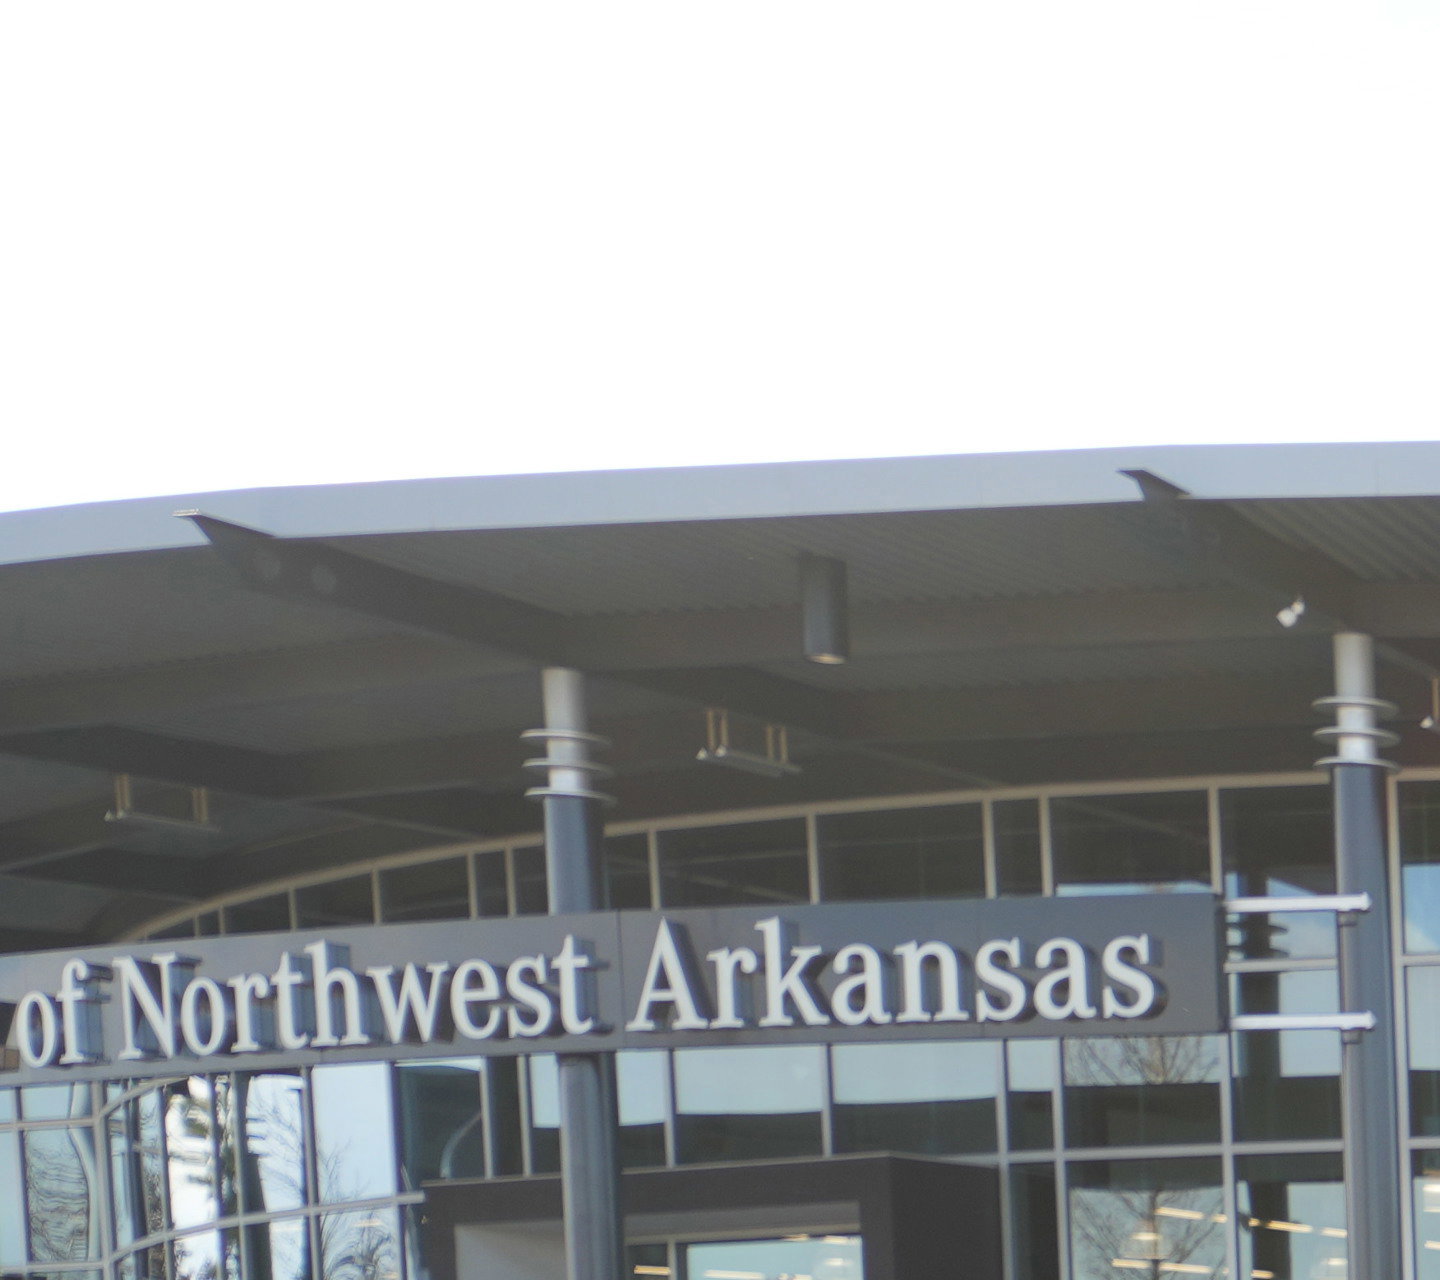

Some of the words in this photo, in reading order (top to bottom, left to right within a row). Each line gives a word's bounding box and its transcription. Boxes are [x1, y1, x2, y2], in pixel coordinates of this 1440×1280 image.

[16, 957, 88, 1068] of
[113, 934, 594, 1060] Northwest
[626, 917, 1157, 1034] Arkansas
